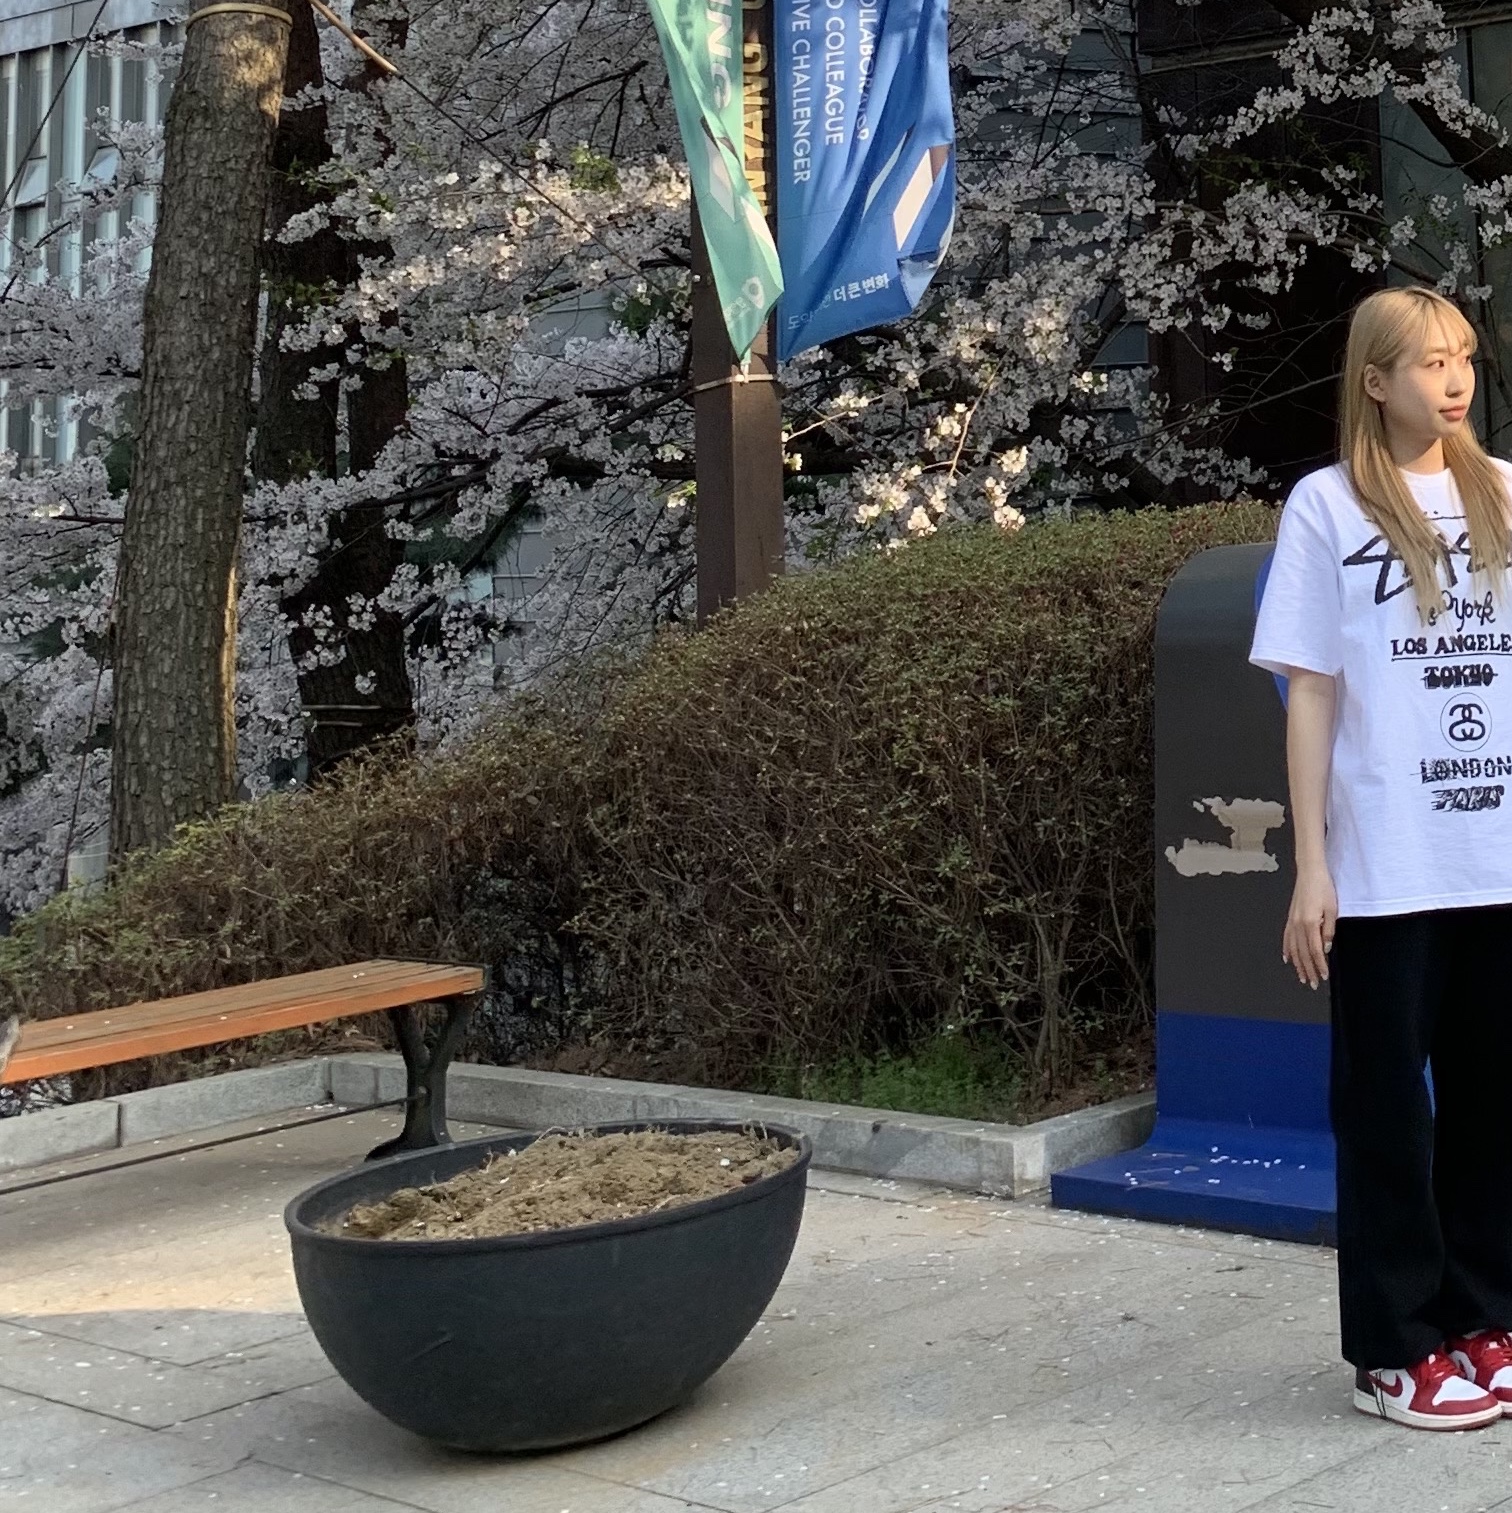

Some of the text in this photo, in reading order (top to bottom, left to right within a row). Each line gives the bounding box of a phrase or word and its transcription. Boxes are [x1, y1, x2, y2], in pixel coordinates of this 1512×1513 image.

[824, 16, 846, 146] COLLEAGUE
[792, 38, 812, 185] CHALLENGER
[832, 287, 847, 302] 더
[847, 282, 862, 299] 큰
[861, 272, 889, 295] 변화
[1451, 591, 1496, 633] York
[1390, 637, 1428, 657] LOS
[1422, 662, 1496, 690] TOKYO
[1418, 755, 1512, 783] LONDON
